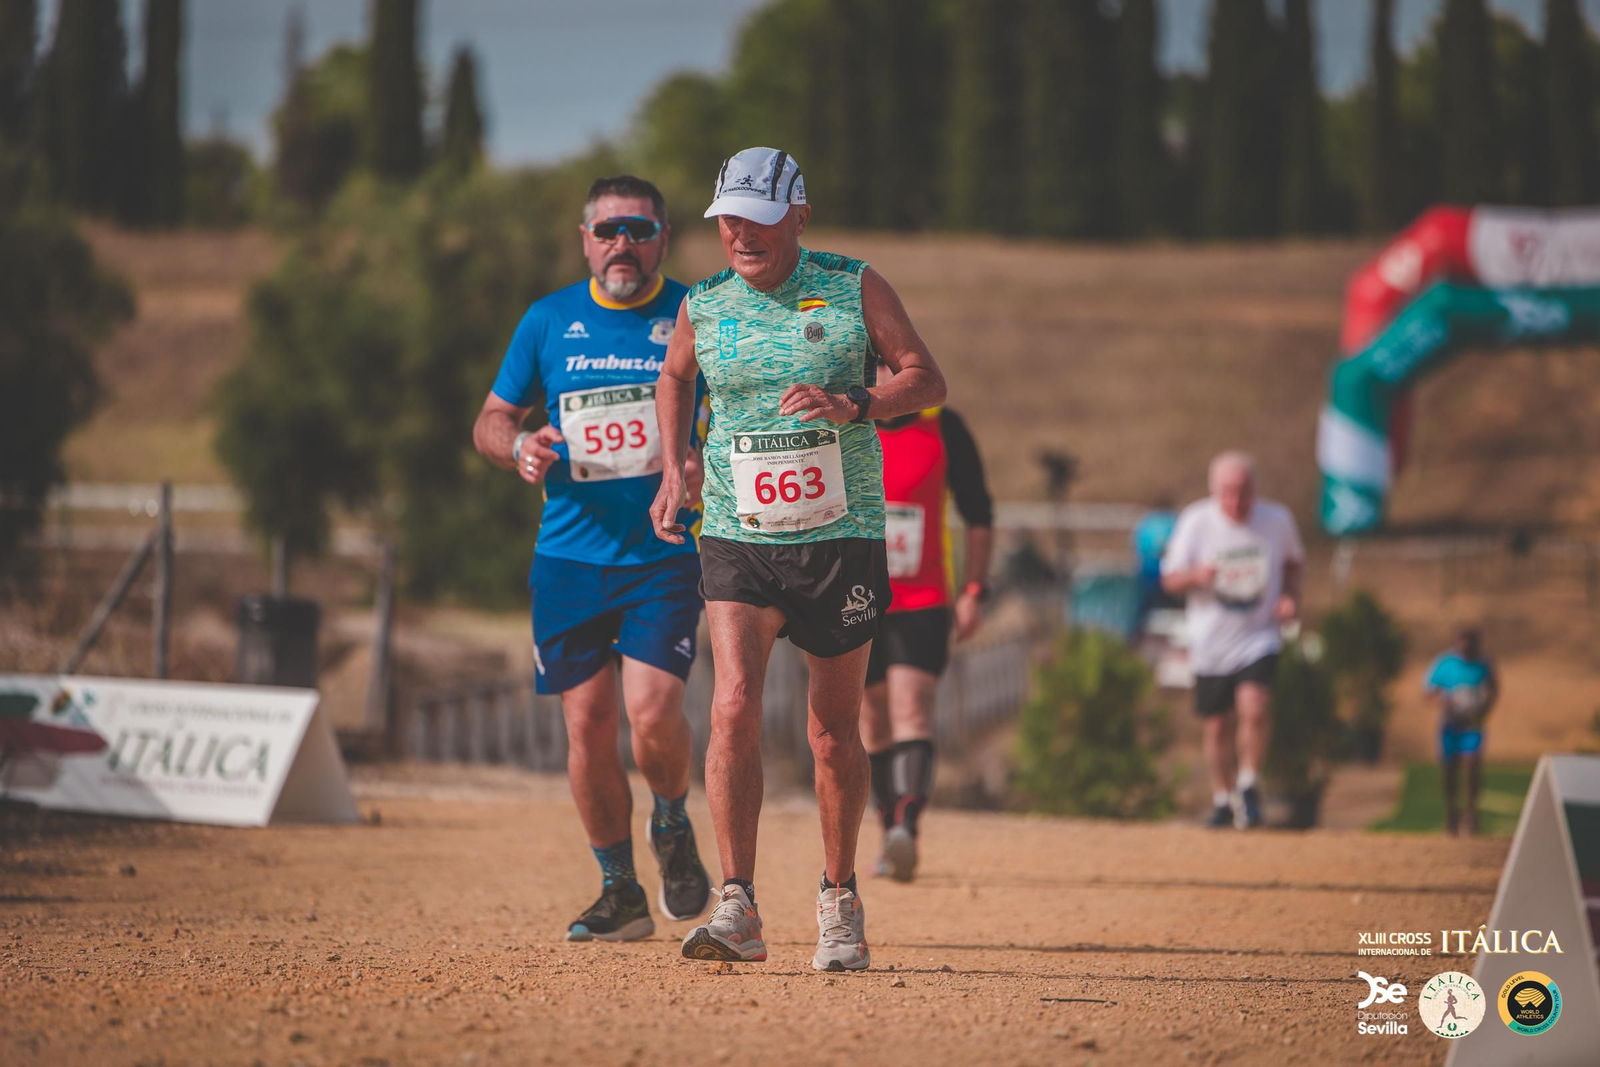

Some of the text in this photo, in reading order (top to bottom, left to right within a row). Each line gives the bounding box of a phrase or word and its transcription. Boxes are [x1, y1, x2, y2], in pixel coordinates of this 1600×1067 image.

[584, 419, 648, 455] 593
[758, 435, 810, 449] ITÁLICA
[754, 466, 826, 505] 663
[107, 719, 270, 782] ITÁLICA
